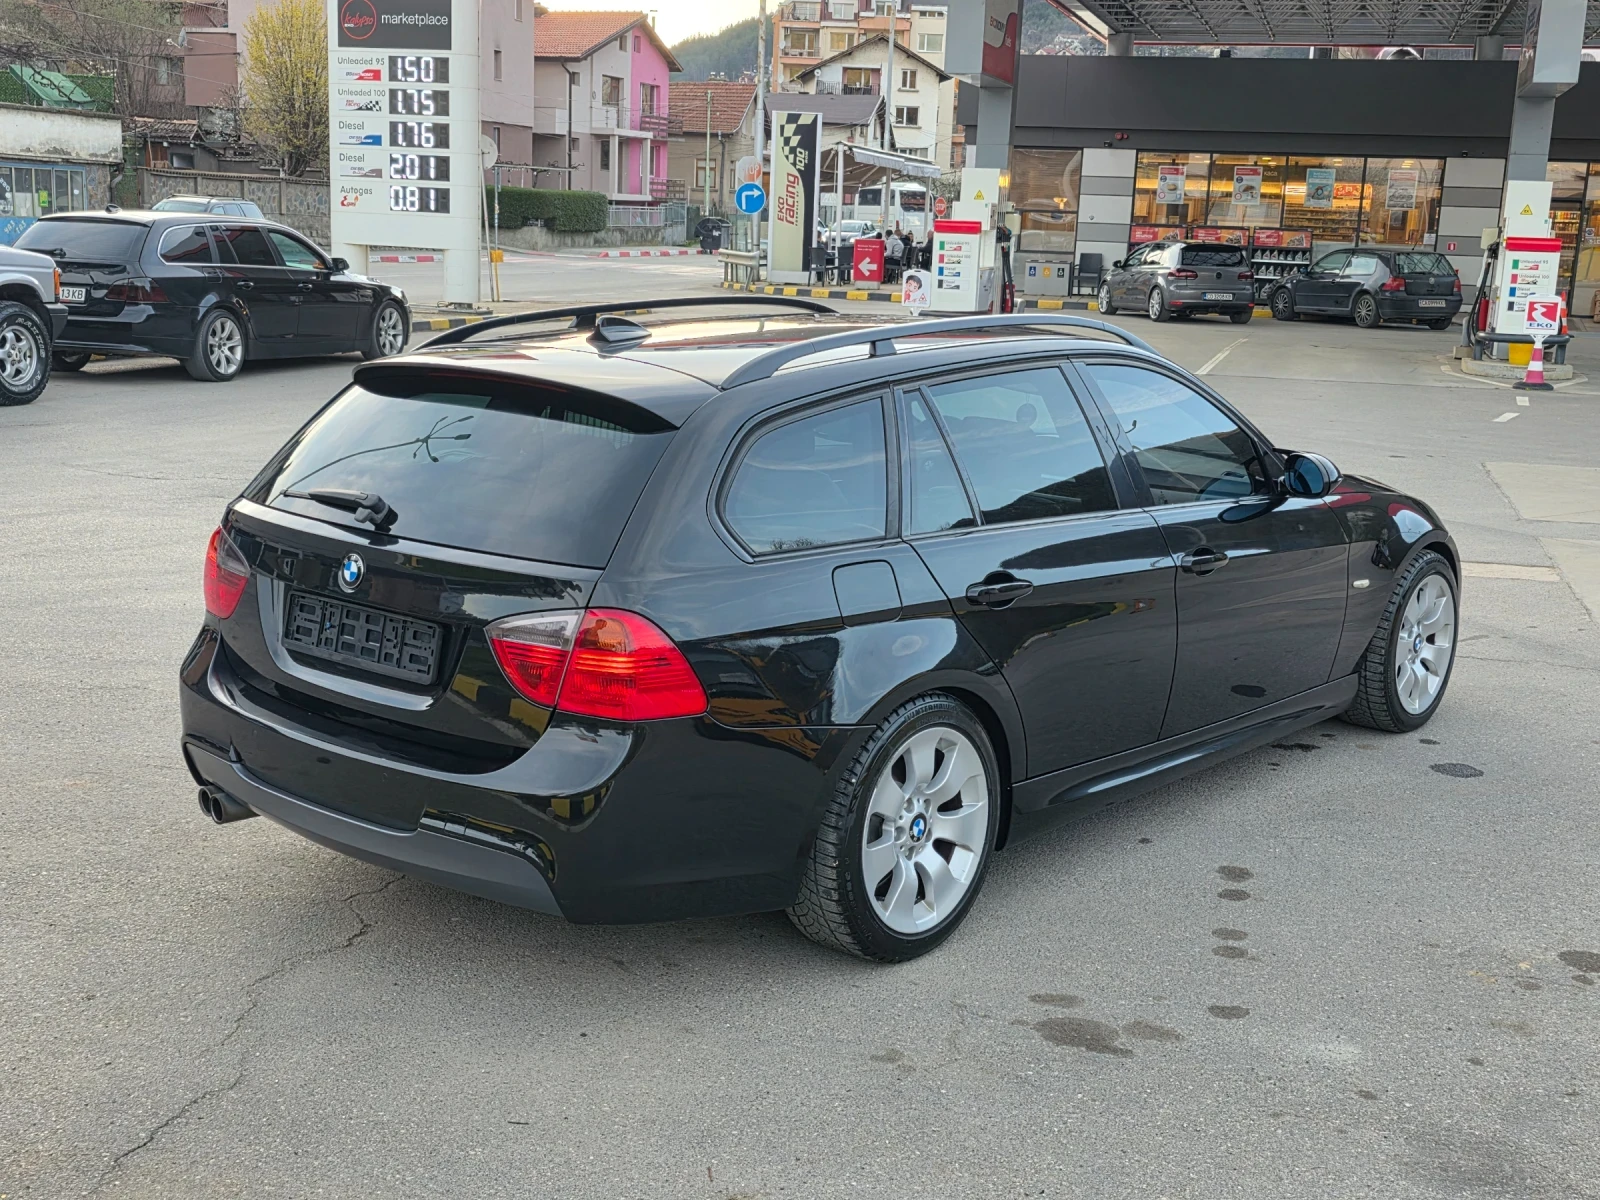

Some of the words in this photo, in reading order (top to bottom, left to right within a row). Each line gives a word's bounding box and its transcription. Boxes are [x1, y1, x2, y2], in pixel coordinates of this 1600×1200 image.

[381, 13, 449, 27] marketplace
[337, 57, 373, 65] Unleaded
[376, 58, 385, 66] 95
[397, 56, 434, 82] 1.50
[337, 88, 372, 97] Unleaded
[374, 89, 386, 97] 100
[397, 89, 434, 115] 1.75
[338, 120, 364, 130] Diesel
[397, 121, 434, 148] 1.76
[339, 153, 365, 162] Diesel
[390, 153, 435, 179] 2.01
[796, 147, 805, 171] 100
[340, 186, 373, 196] Autogas
[390, 185, 435, 211] 0.81
[785, 172, 800, 226] racing
[777, 196, 785, 222] EKO
[60, 288, 84, 300] 13KB
